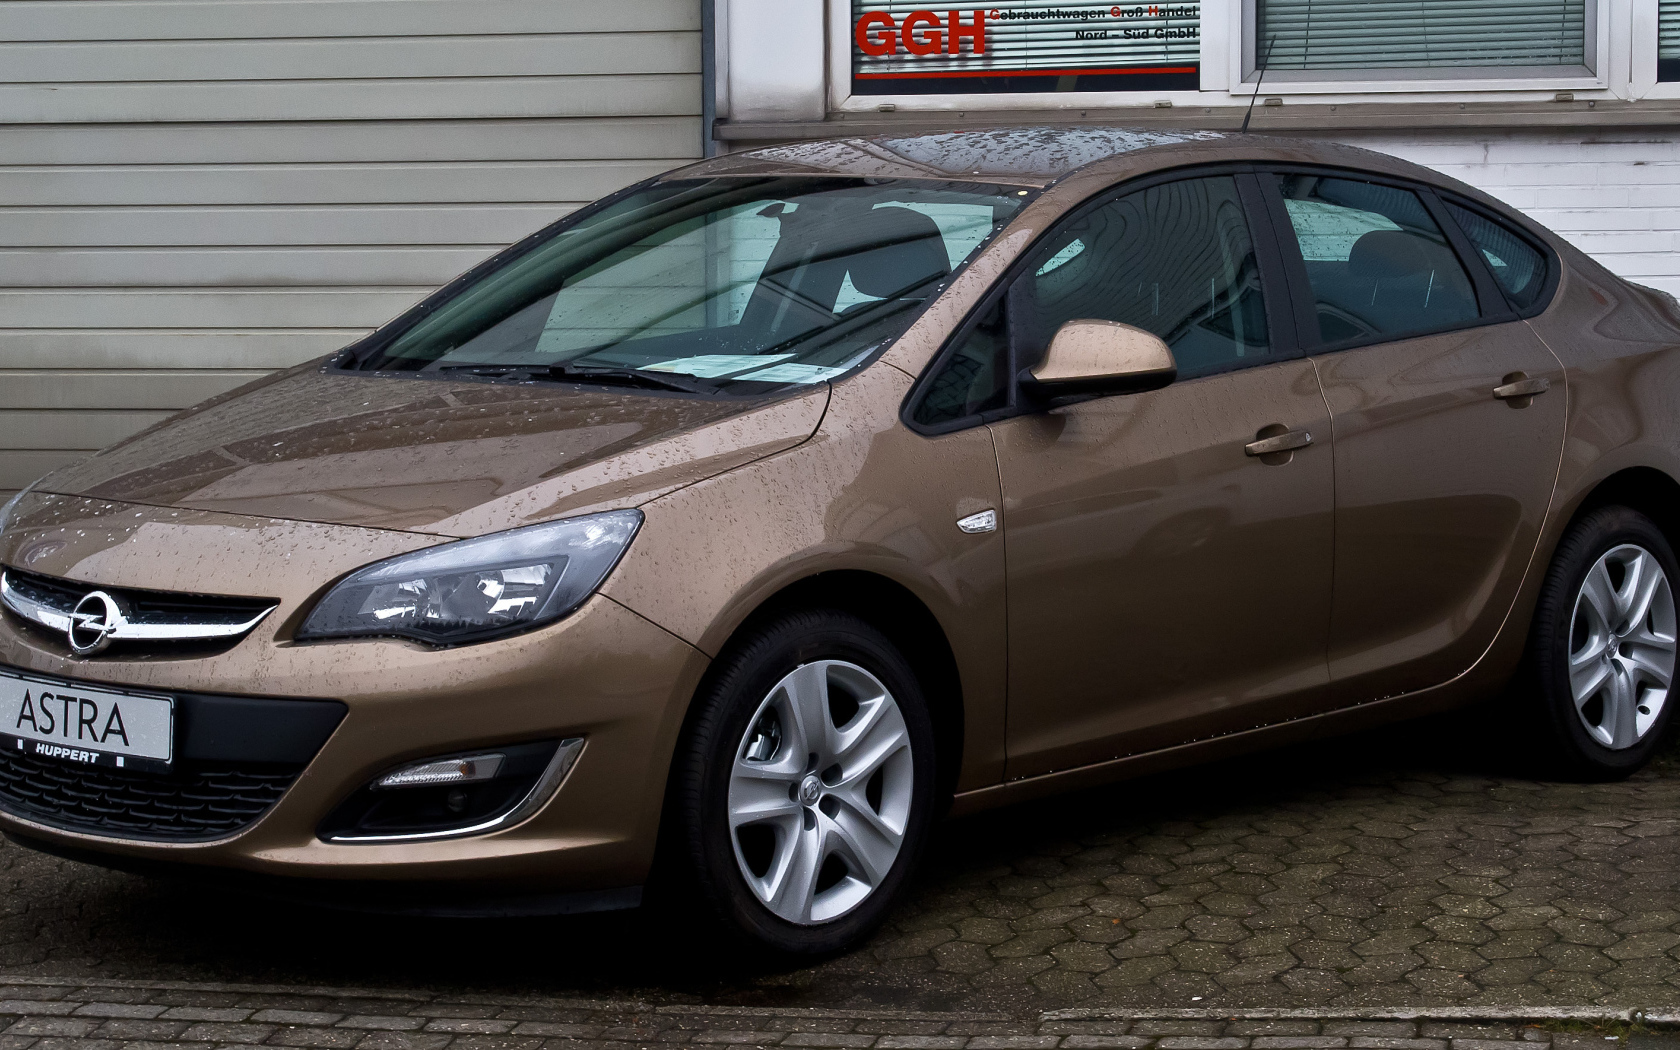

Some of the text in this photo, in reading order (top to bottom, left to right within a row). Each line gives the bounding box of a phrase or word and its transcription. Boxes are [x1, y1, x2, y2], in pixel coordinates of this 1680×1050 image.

[989, 5, 1197, 22] Gebrauchtwagen Groß Handel
[855, 10, 985, 56] GGH
[1075, 29, 1107, 41] Nord
[1123, 27, 1150, 40] Süd
[1154, 27, 1197, 40] GmbH
[16, 688, 130, 747] ASTRA
[35, 742, 100, 764] HUPPERT
